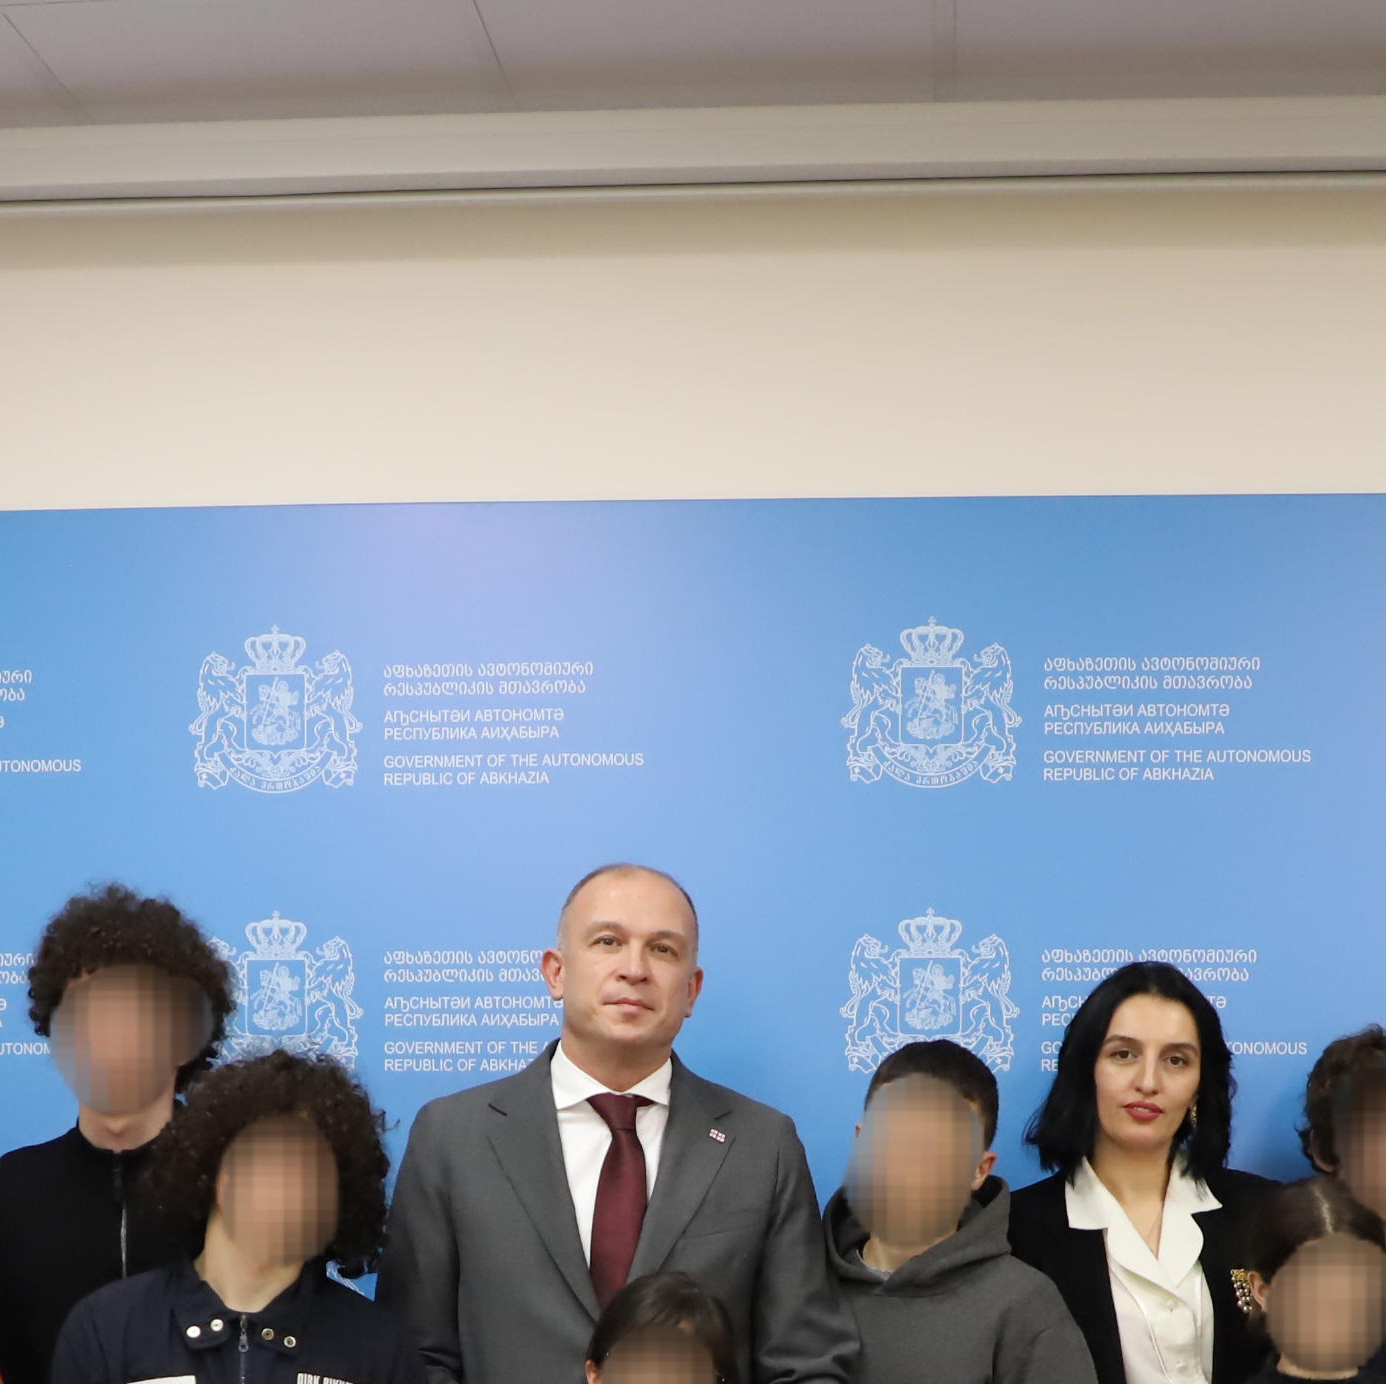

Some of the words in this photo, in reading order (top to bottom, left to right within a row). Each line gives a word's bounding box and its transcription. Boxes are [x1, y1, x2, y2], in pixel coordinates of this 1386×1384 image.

[384, 724, 478, 740] РЕСПУБЛИКА
[1044, 721, 1141, 735] РЕСПУБЛИКА
[383, 755, 484, 768] GOVERNMENT
[486, 754, 506, 767] OF
[510, 753, 539, 766] THE
[542, 753, 645, 766] AUTONOMOUS
[1043, 750, 1147, 763] GOVERNMENT
[1149, 750, 1171, 763] OF
[1173, 750, 1203, 763] THE
[1206, 749, 1312, 763] AUTONOMOUS
[383, 772, 453, 785] REPUBLIC
[456, 772, 476, 784] OF
[479, 771, 550, 784] ABKHAZIA
[1043, 768, 1116, 781] REPUBLIC
[1118, 768, 1140, 780] OF
[1142, 768, 1215, 780] ABKHAZIA
[384, 1013, 478, 1027] РЕСПУБЛИКА
[383, 1041, 484, 1055] GOVERNMENT
[486, 1041, 507, 1054] OF
[510, 1041, 539, 1055] THE
[383, 1058, 454, 1072] REPUBLIC
[456, 1058, 477, 1072] OF
